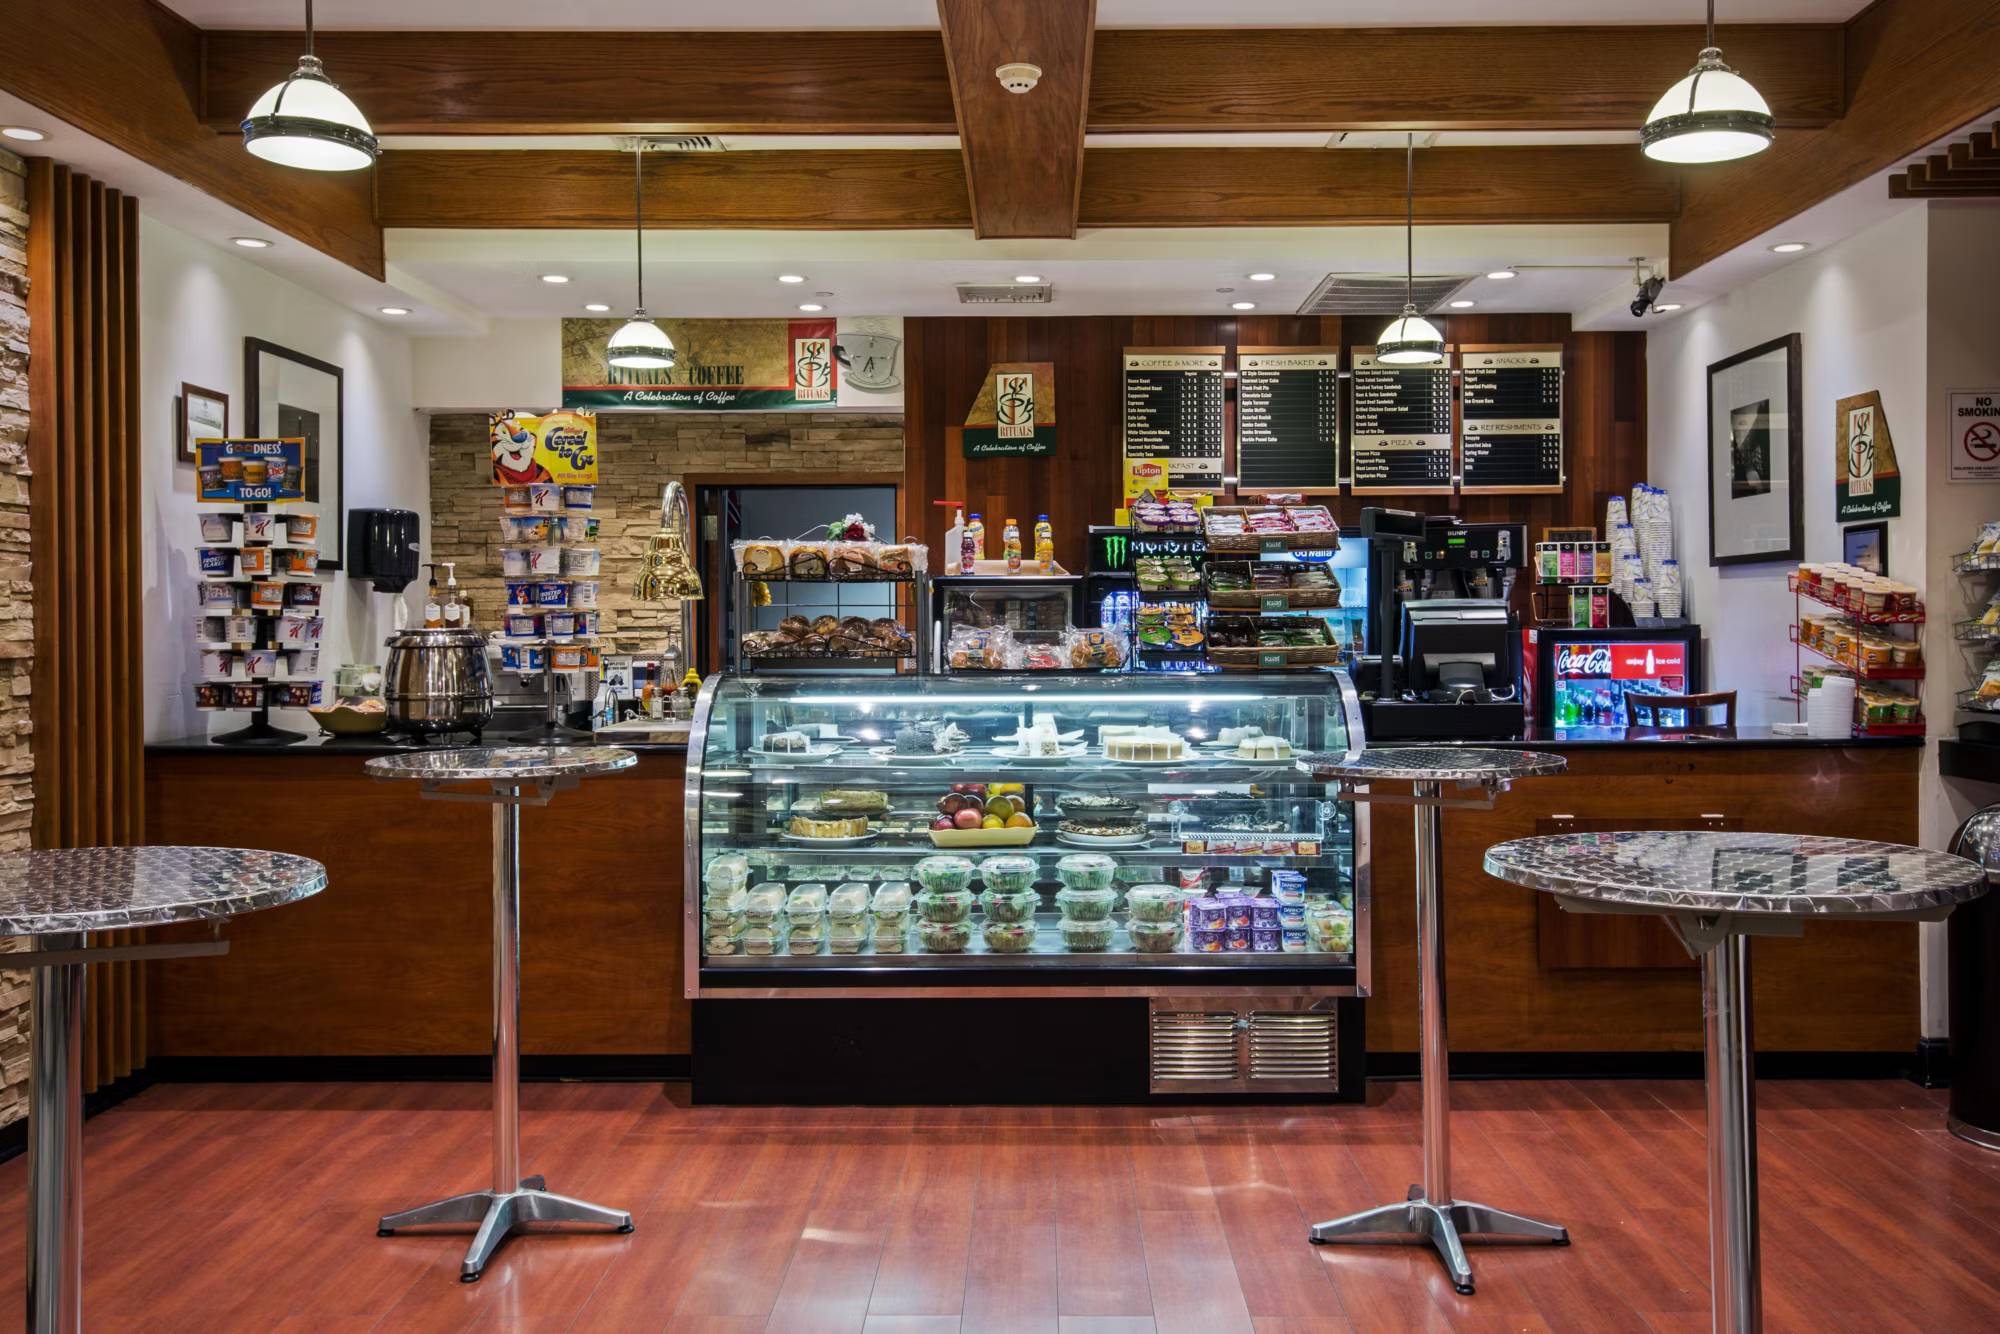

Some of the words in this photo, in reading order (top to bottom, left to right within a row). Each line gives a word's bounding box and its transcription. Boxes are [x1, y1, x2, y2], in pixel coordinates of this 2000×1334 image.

[689, 366, 744, 385] COFFEE
[623, 391, 633, 401] A
[635, 391, 691, 401] Celebration
[693, 391, 704, 404] of
[706, 391, 736, 404] Coffee
[797, 389, 829, 399] RITUALS
[1976, 398, 1992, 406] NO
[1000, 425, 1033, 437] RITUALS
[545, 427, 588, 451] Cereal
[981, 444, 1017, 452] Celebration
[1019, 444, 1026, 452] of
[1027, 443, 1047, 452] Coffee
[559, 447, 572, 458] to
[571, 446, 594, 470] Go
[1850, 479, 1873, 494] RITUALS
[239, 488, 272, 498] TO-GO!
[1841, 506, 1846, 514] A
[1846, 503, 1871, 514] Celebration
[1871, 502, 1877, 513] of
[1877, 501, 1892, 511] Coffee
[1131, 542, 1209, 553] MONSTER
